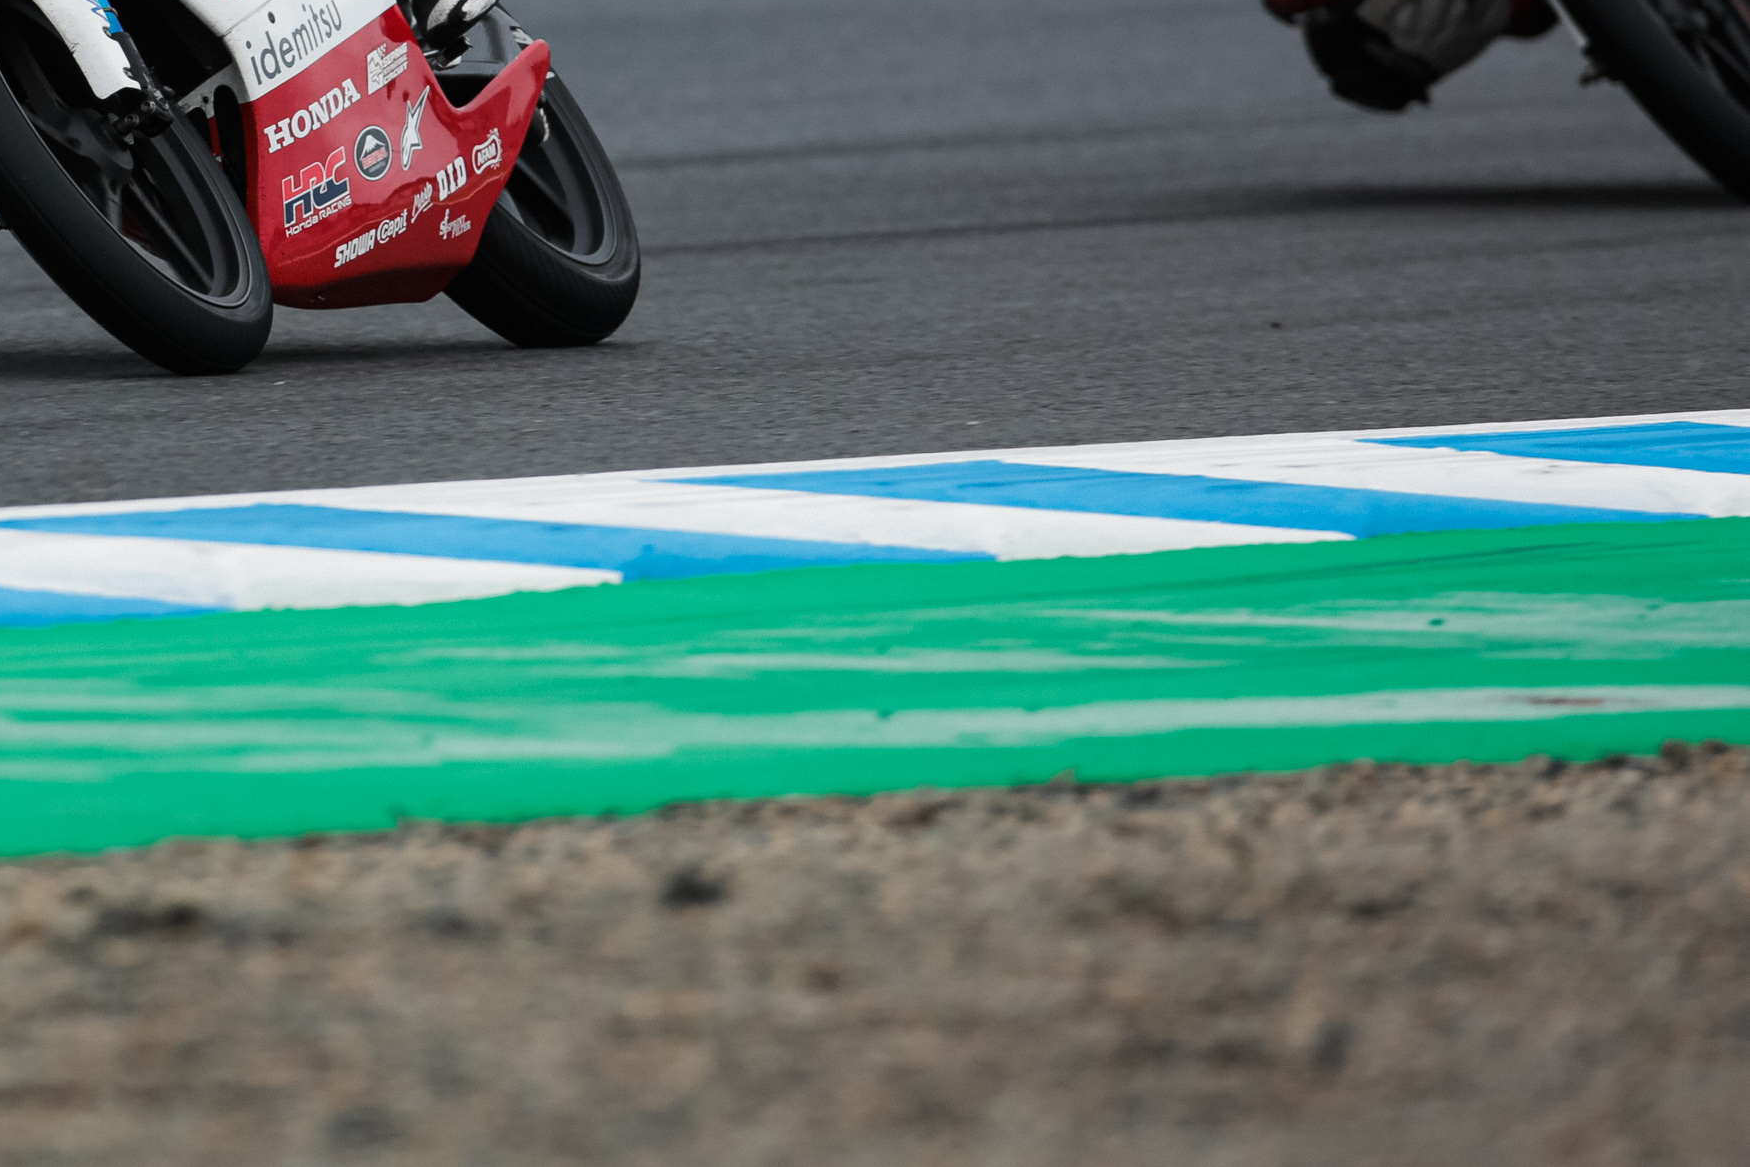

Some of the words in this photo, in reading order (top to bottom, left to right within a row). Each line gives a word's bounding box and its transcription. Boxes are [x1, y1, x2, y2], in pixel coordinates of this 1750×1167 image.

[263, 77, 362, 154] HONDA
[476, 142, 497, 166] AFAM
[285, 215, 319, 238] Honda
[318, 195, 353, 220] RACING
[333, 228, 377, 269] SHOWA
